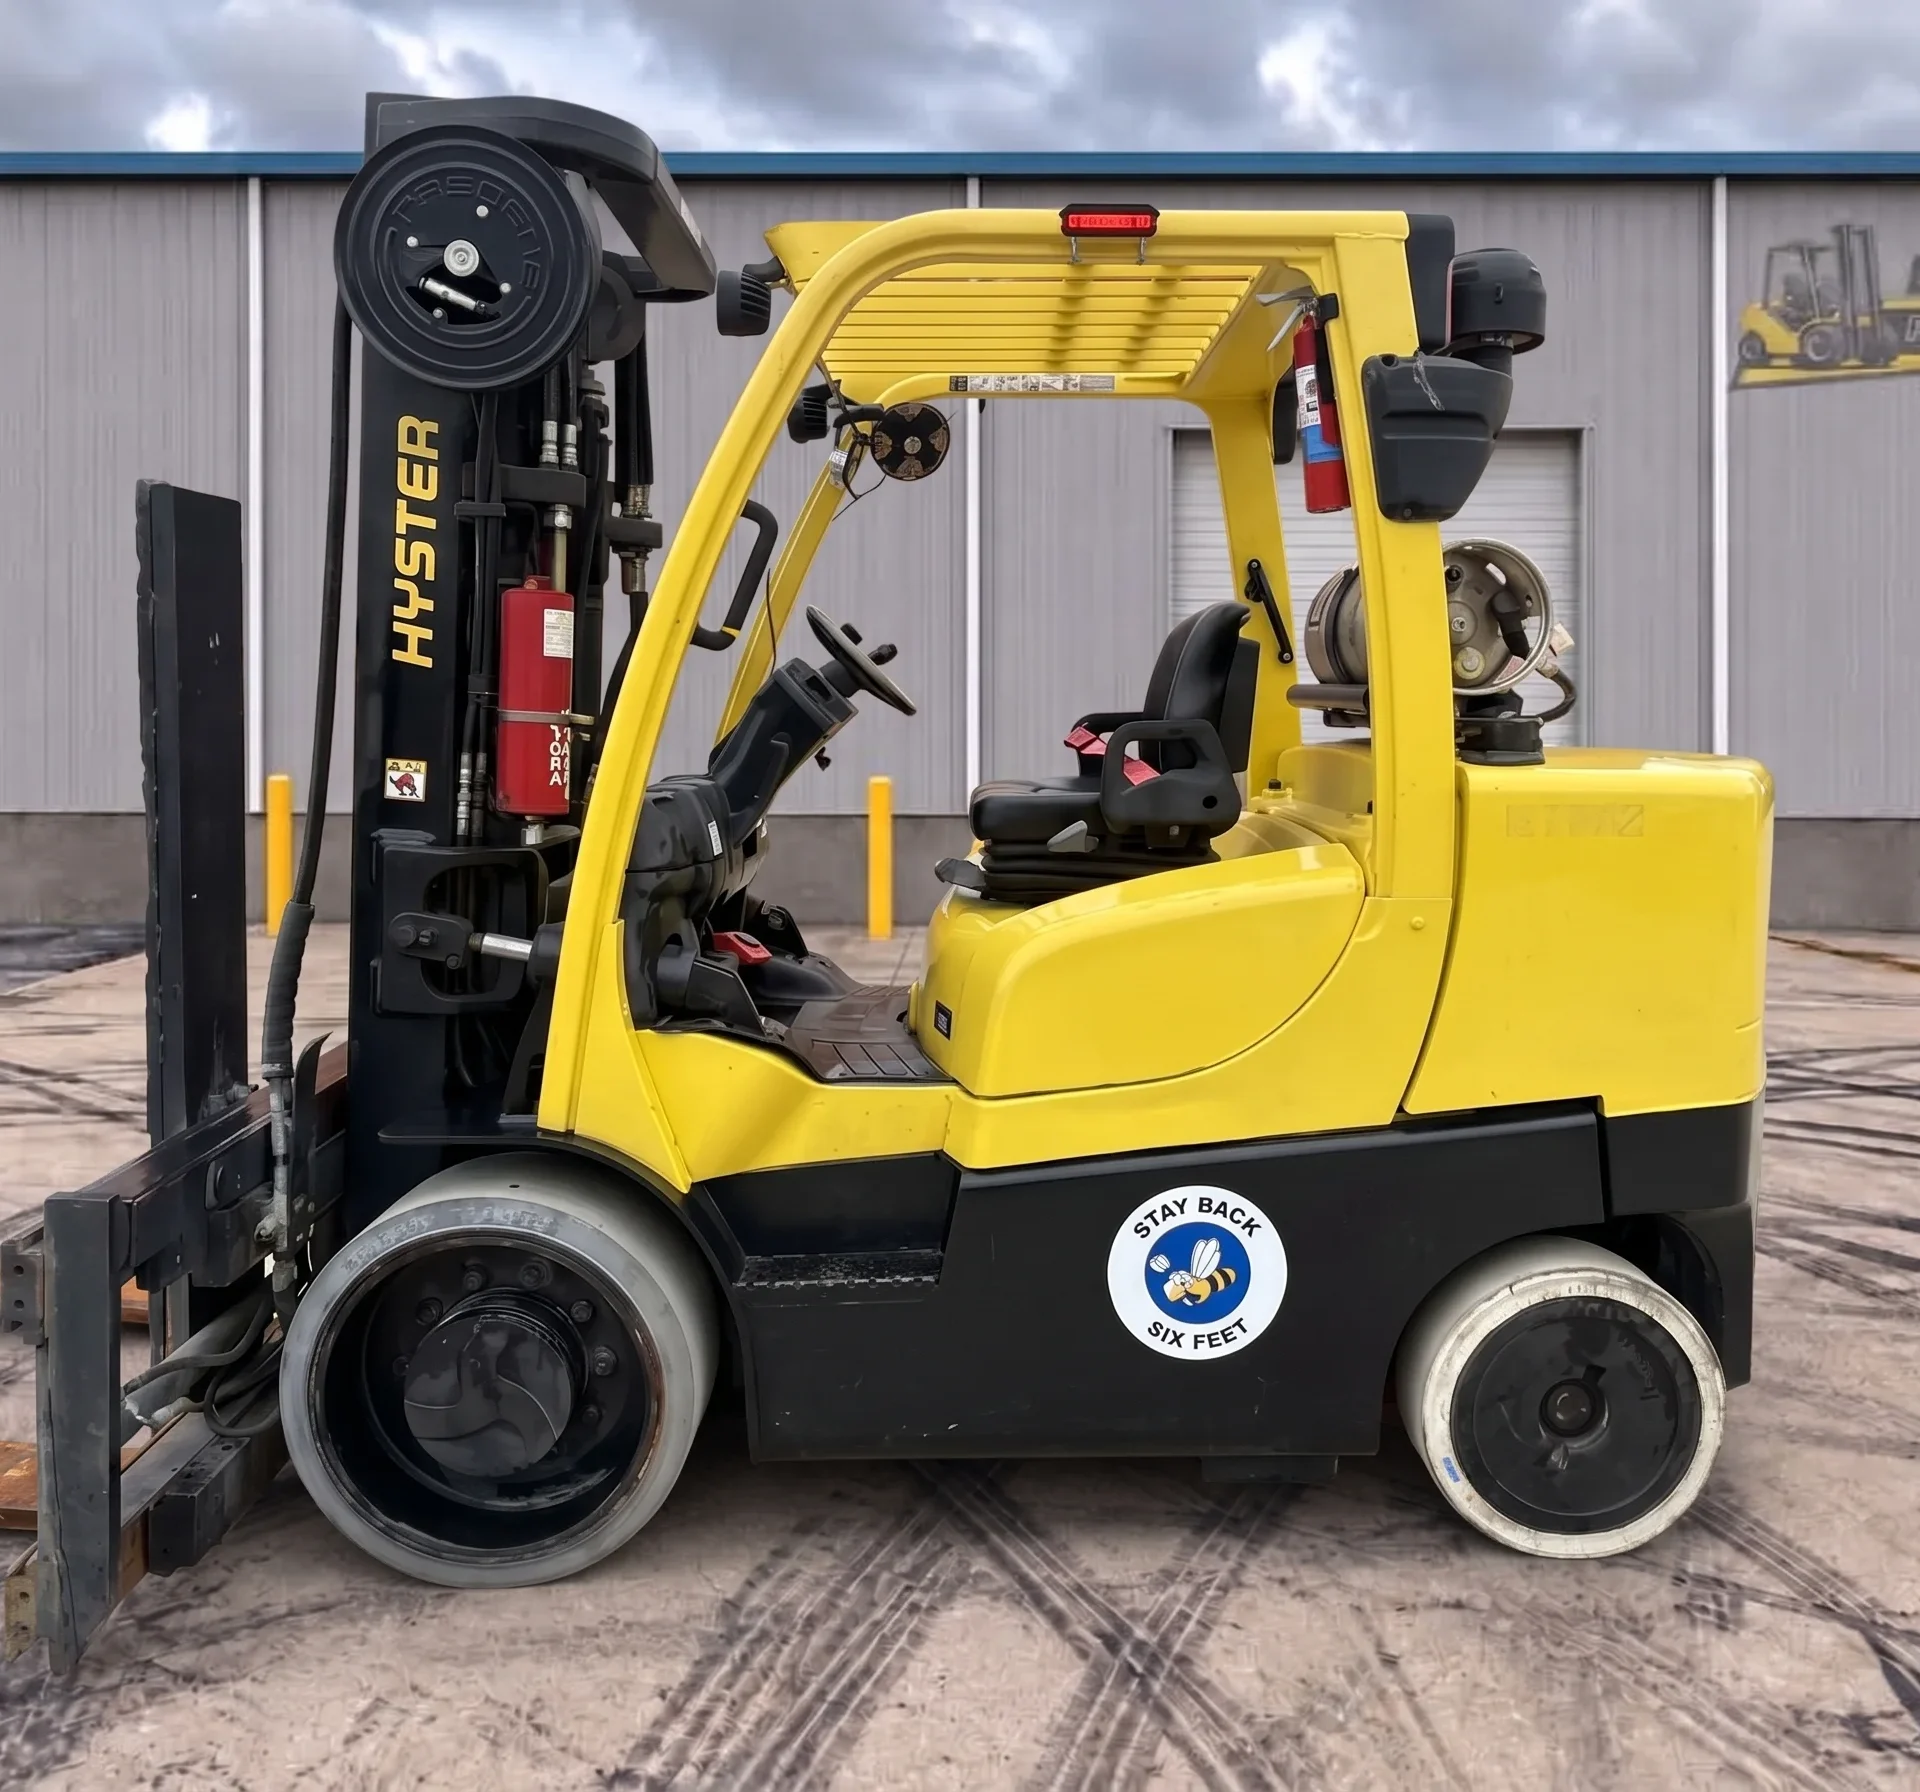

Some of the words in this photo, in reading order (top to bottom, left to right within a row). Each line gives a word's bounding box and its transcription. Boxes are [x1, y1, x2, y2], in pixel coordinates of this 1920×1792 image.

[391, 413, 440, 669] HYSTER
[1133, 1197, 1188, 1239] STAY
[1197, 1197, 1262, 1238] BACK
[1147, 1320, 1186, 1349] SIX
[1193, 1318, 1248, 1349] FEET
